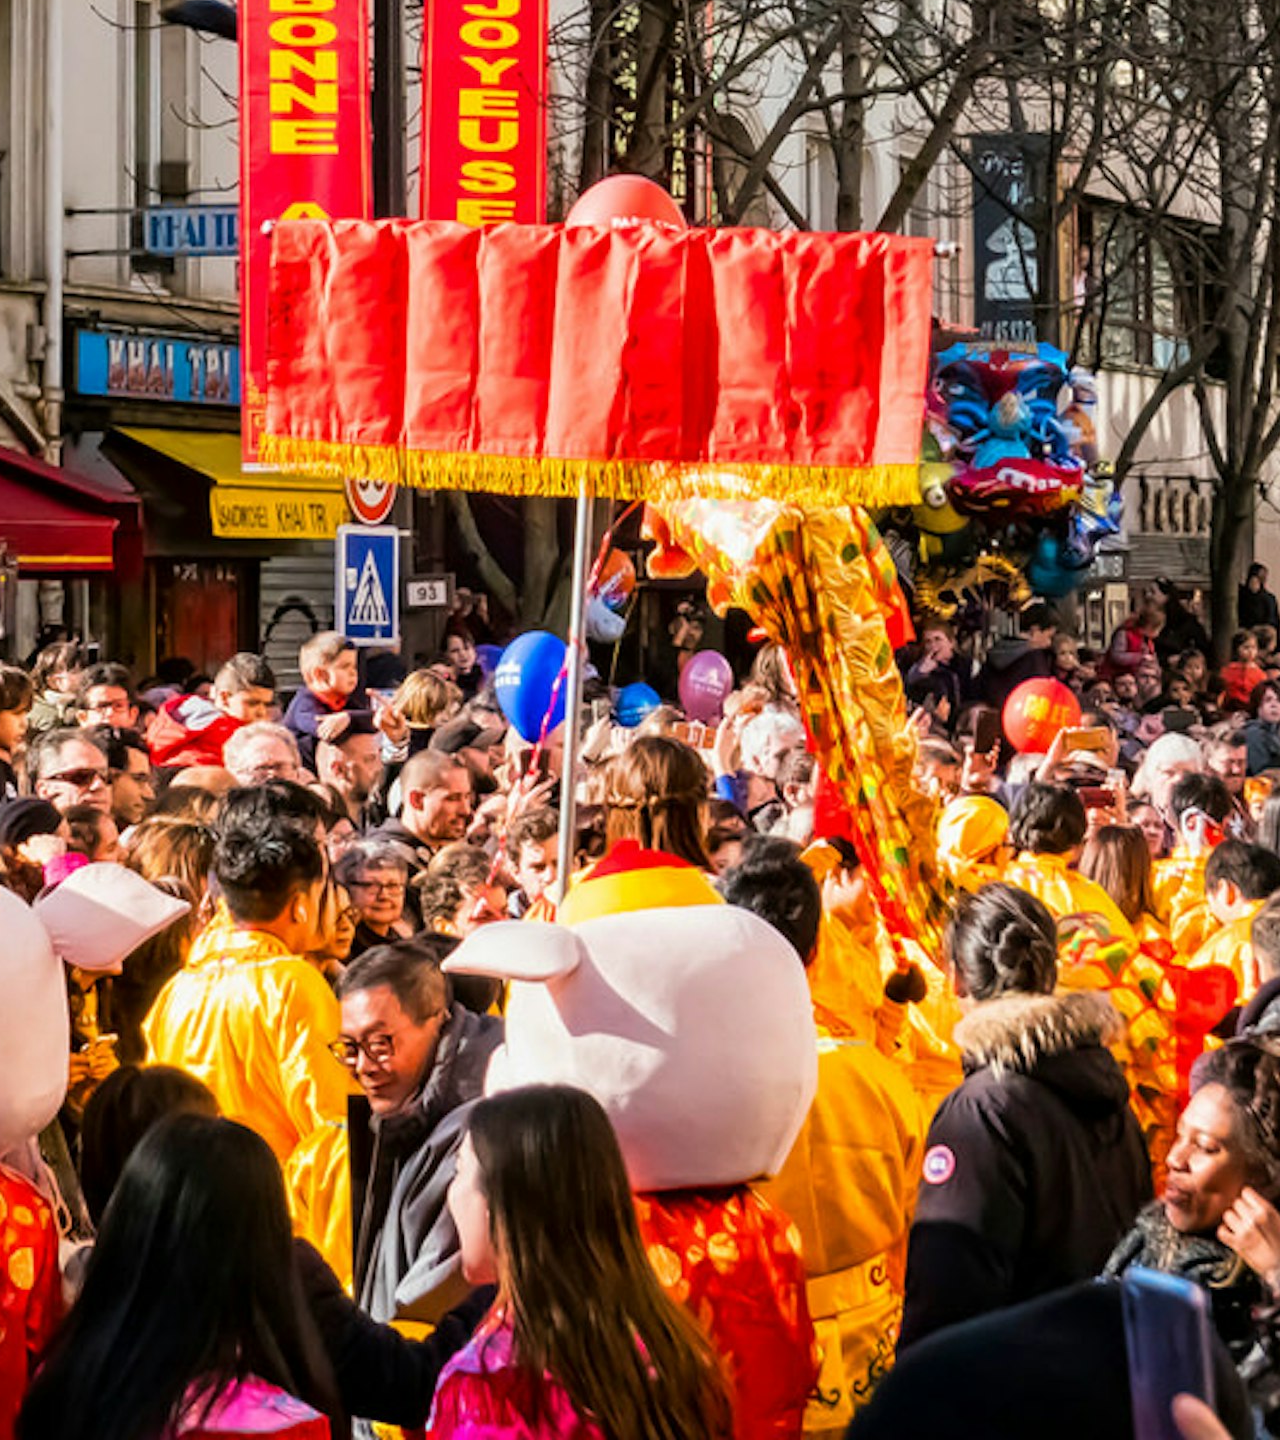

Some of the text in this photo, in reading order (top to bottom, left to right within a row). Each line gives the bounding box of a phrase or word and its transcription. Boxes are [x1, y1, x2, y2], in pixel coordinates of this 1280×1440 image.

[108, 339, 231, 399] KHAI TRI
[416, 585, 438, 601] 93
